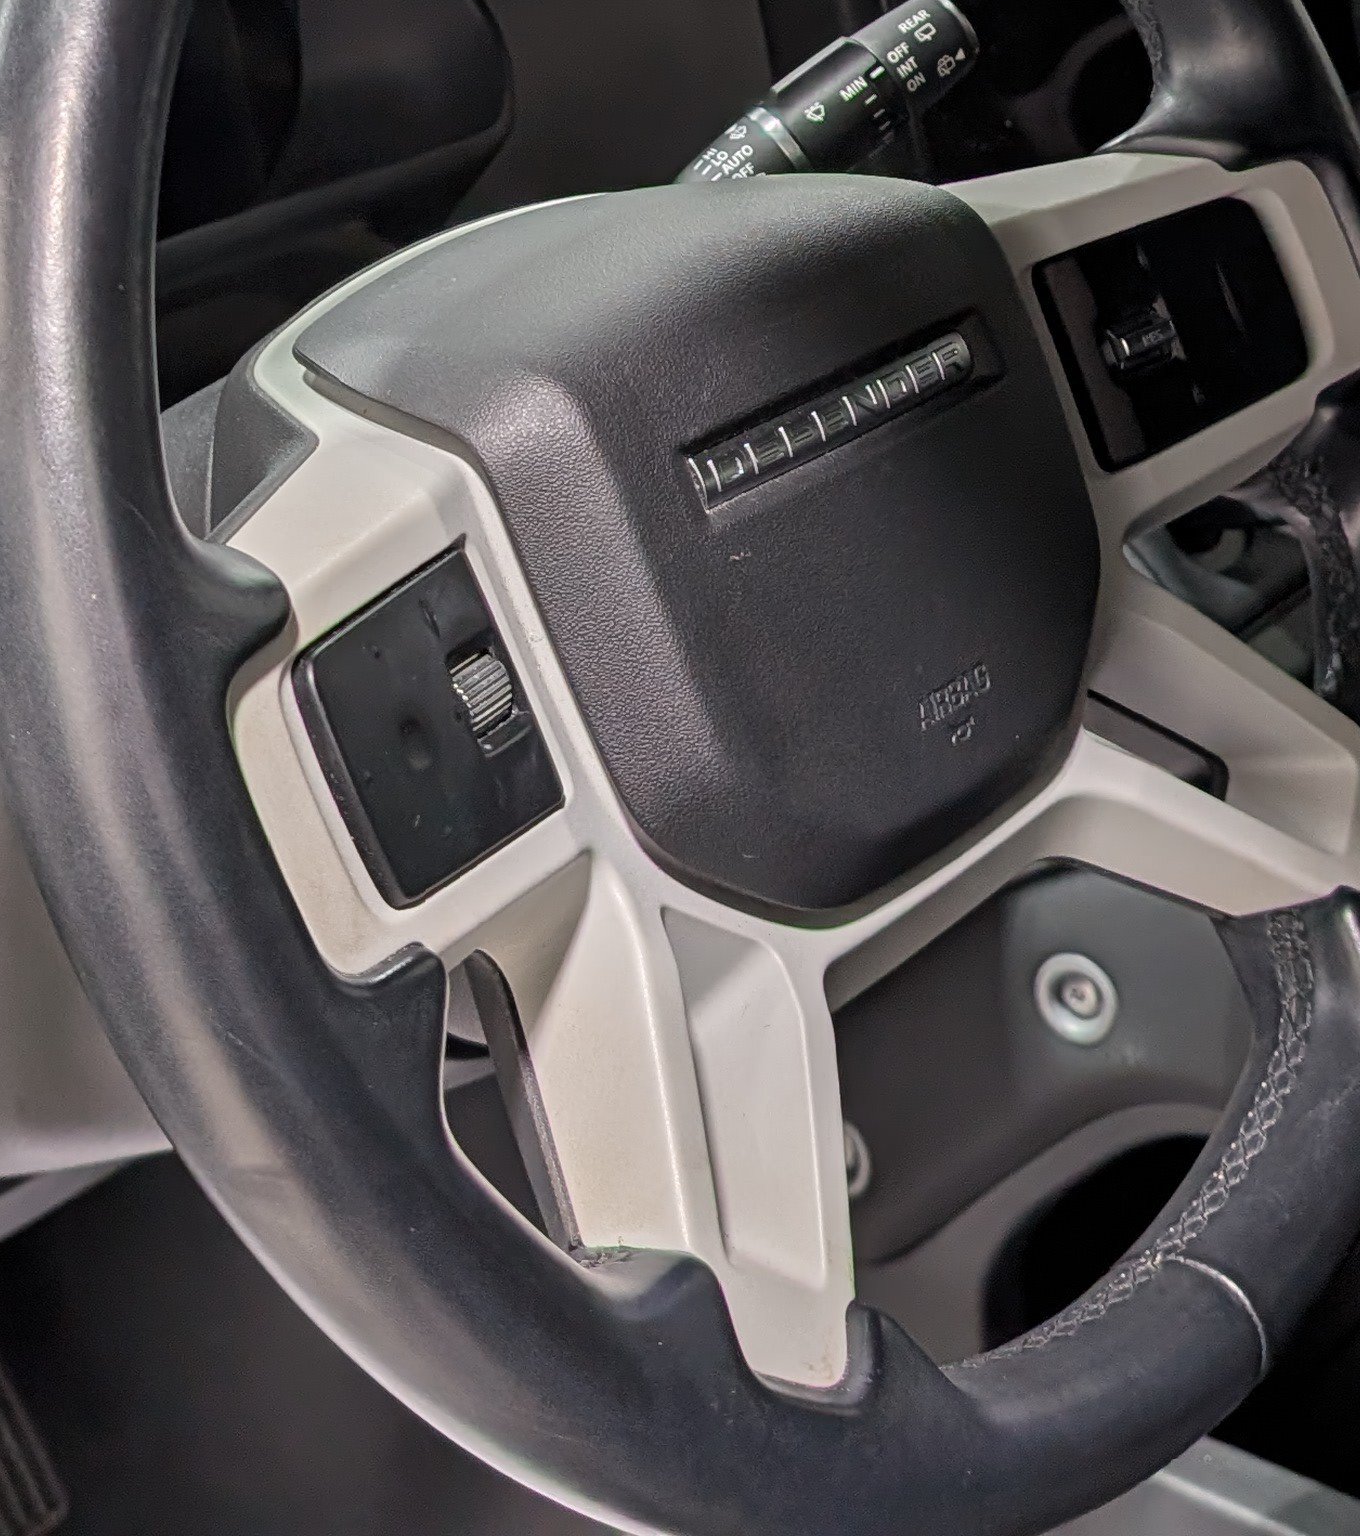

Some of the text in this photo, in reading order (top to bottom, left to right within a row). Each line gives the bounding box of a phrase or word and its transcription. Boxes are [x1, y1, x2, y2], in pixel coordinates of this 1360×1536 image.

[897, 9, 931, 34] REAR
[886, 41, 910, 64] OFF
[896, 56, 919, 79] INT
[839, 75, 869, 102] MIN
[906, 71, 927, 92] ON
[710, 150, 729, 167] LO
[721, 144, 754, 176] AUTO
[707, 339, 968, 494] DEFENDER
[918, 664, 991, 732] AIRBAG
